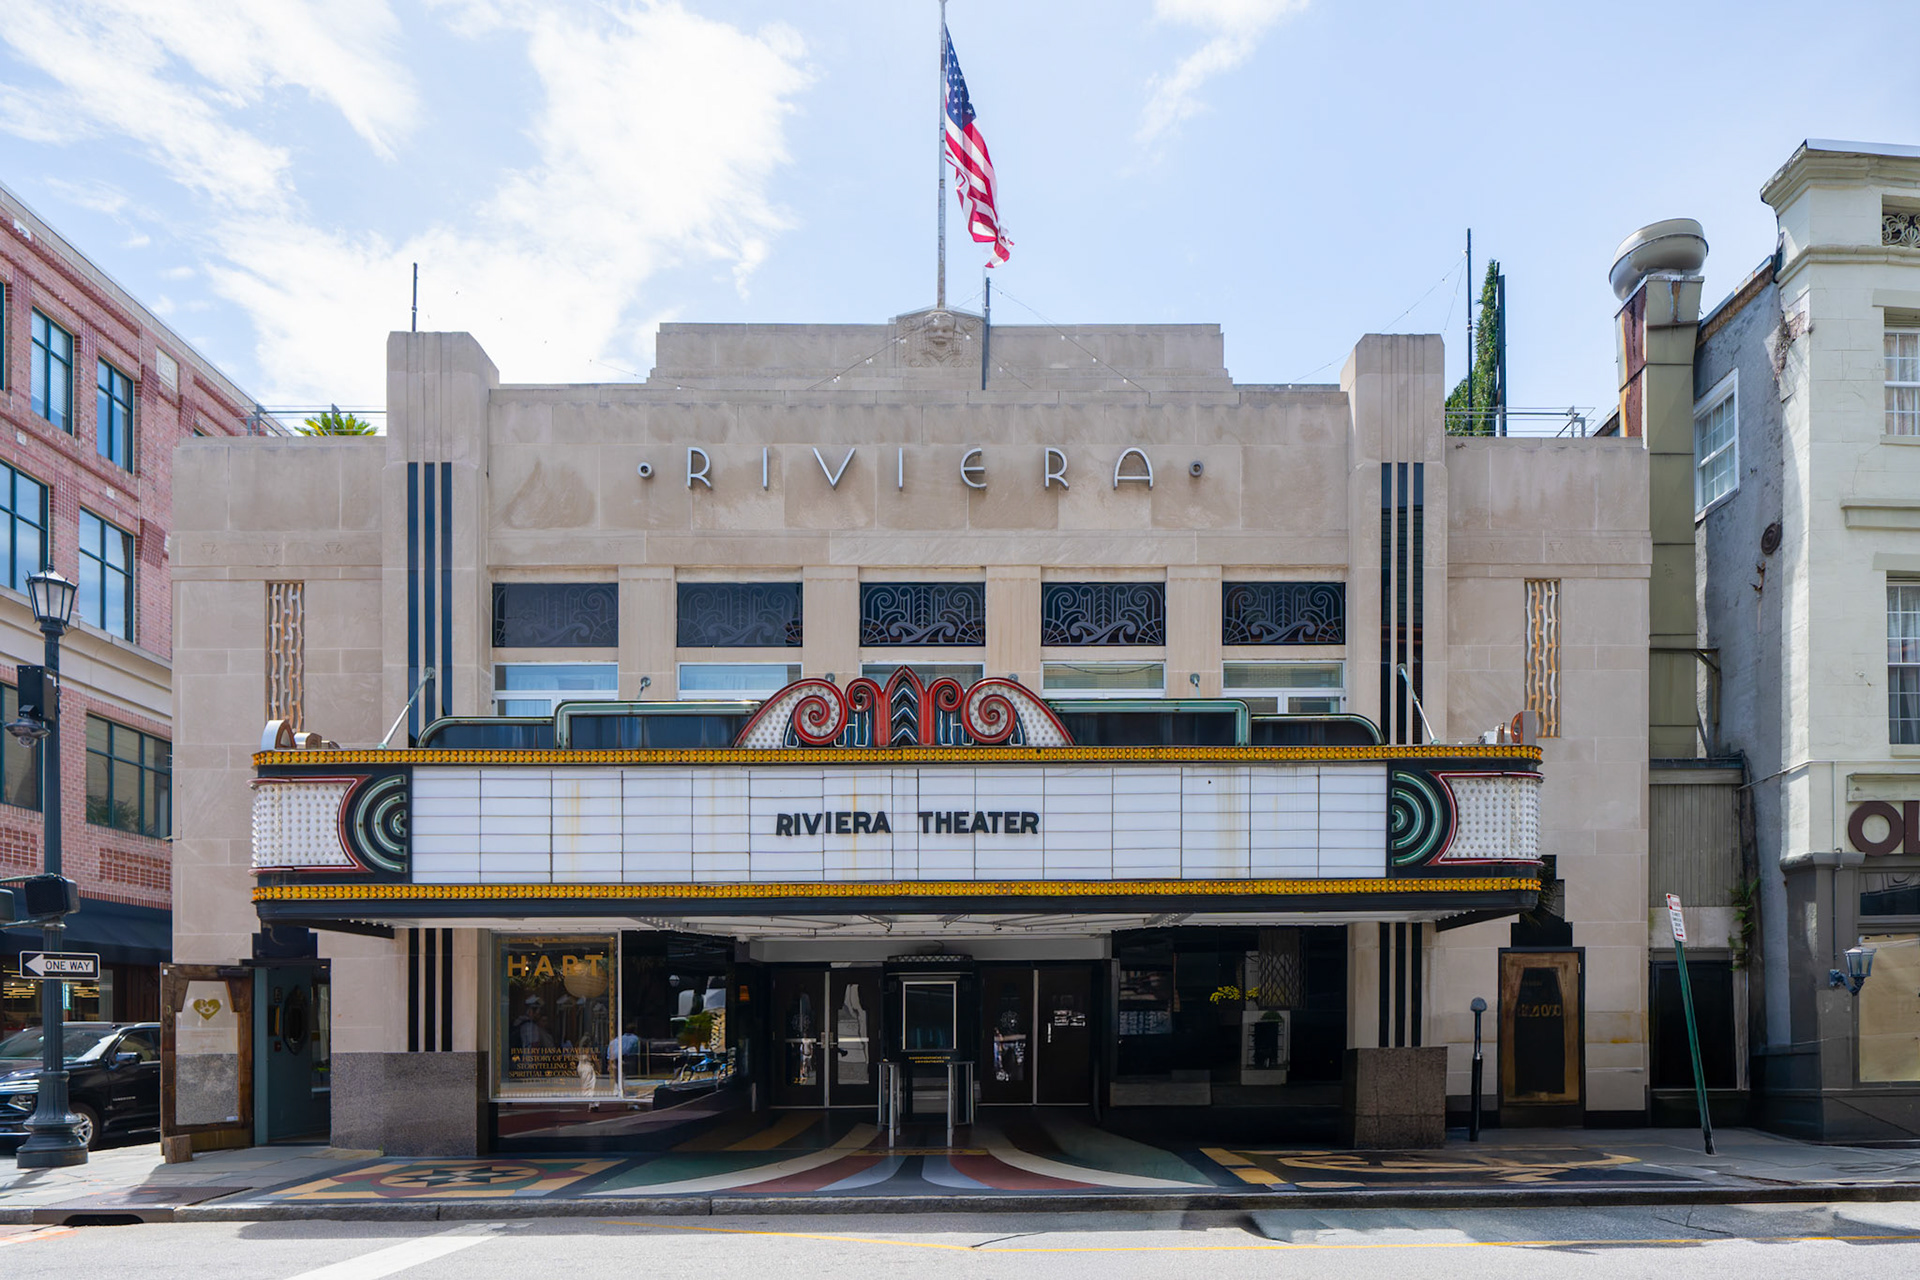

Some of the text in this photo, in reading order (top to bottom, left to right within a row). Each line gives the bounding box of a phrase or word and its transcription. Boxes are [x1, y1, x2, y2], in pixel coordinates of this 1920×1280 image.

[687, 447, 1154, 491] RIVIERA
[775, 811, 1040, 837] RIVIERA THEATER
[45, 960, 90, 971] ONE WAY
[507, 954, 603, 977] HART
